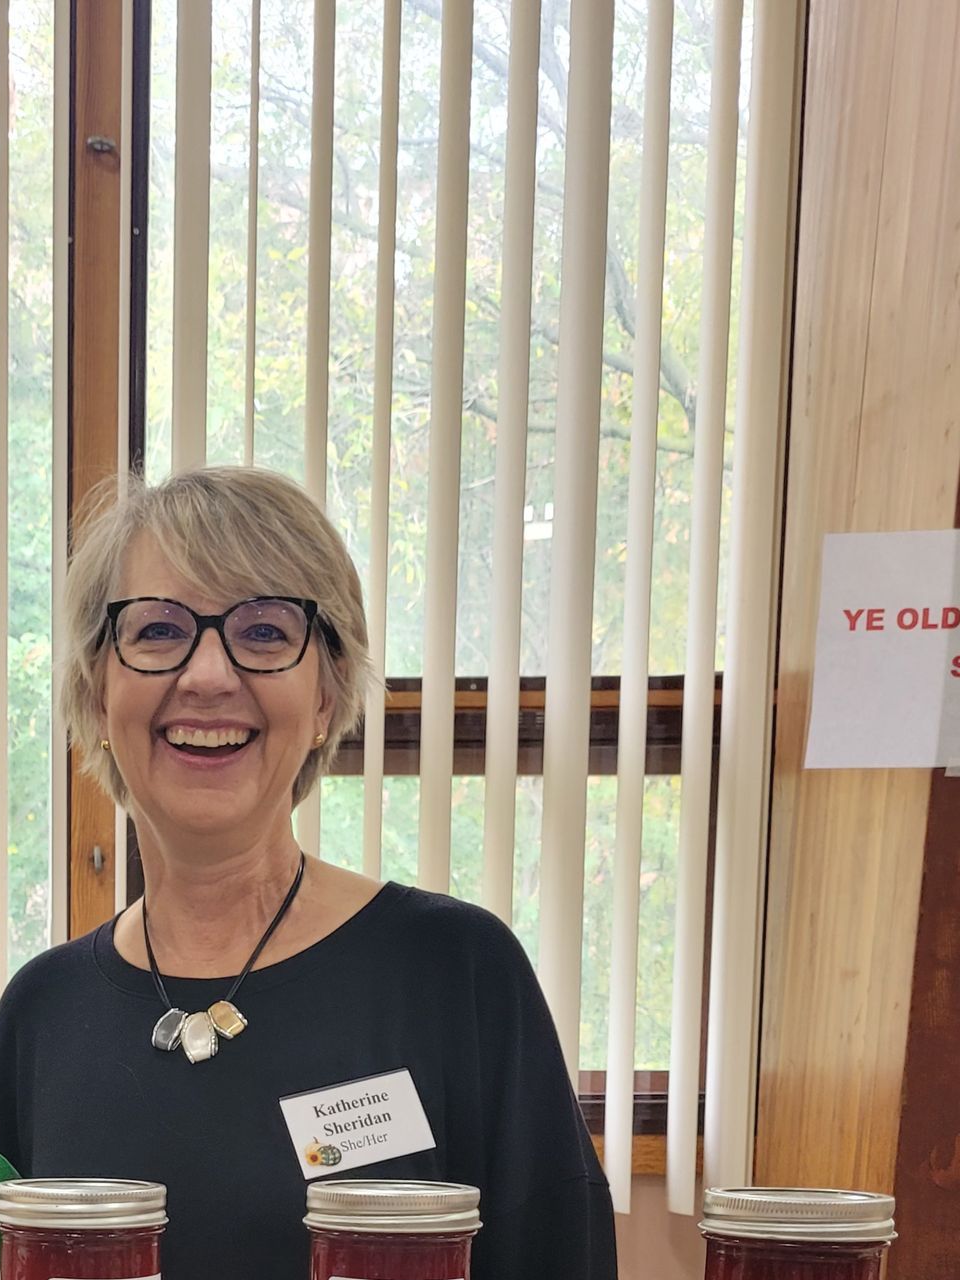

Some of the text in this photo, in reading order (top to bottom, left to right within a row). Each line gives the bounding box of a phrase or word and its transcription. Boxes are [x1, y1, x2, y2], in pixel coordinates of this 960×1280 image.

[843, 607, 960, 631] YE OLD
[313, 1091, 390, 1118] Katherine
[323, 1112, 392, 1137] Sheridan
[340, 1132, 389, 1153] She/Her
